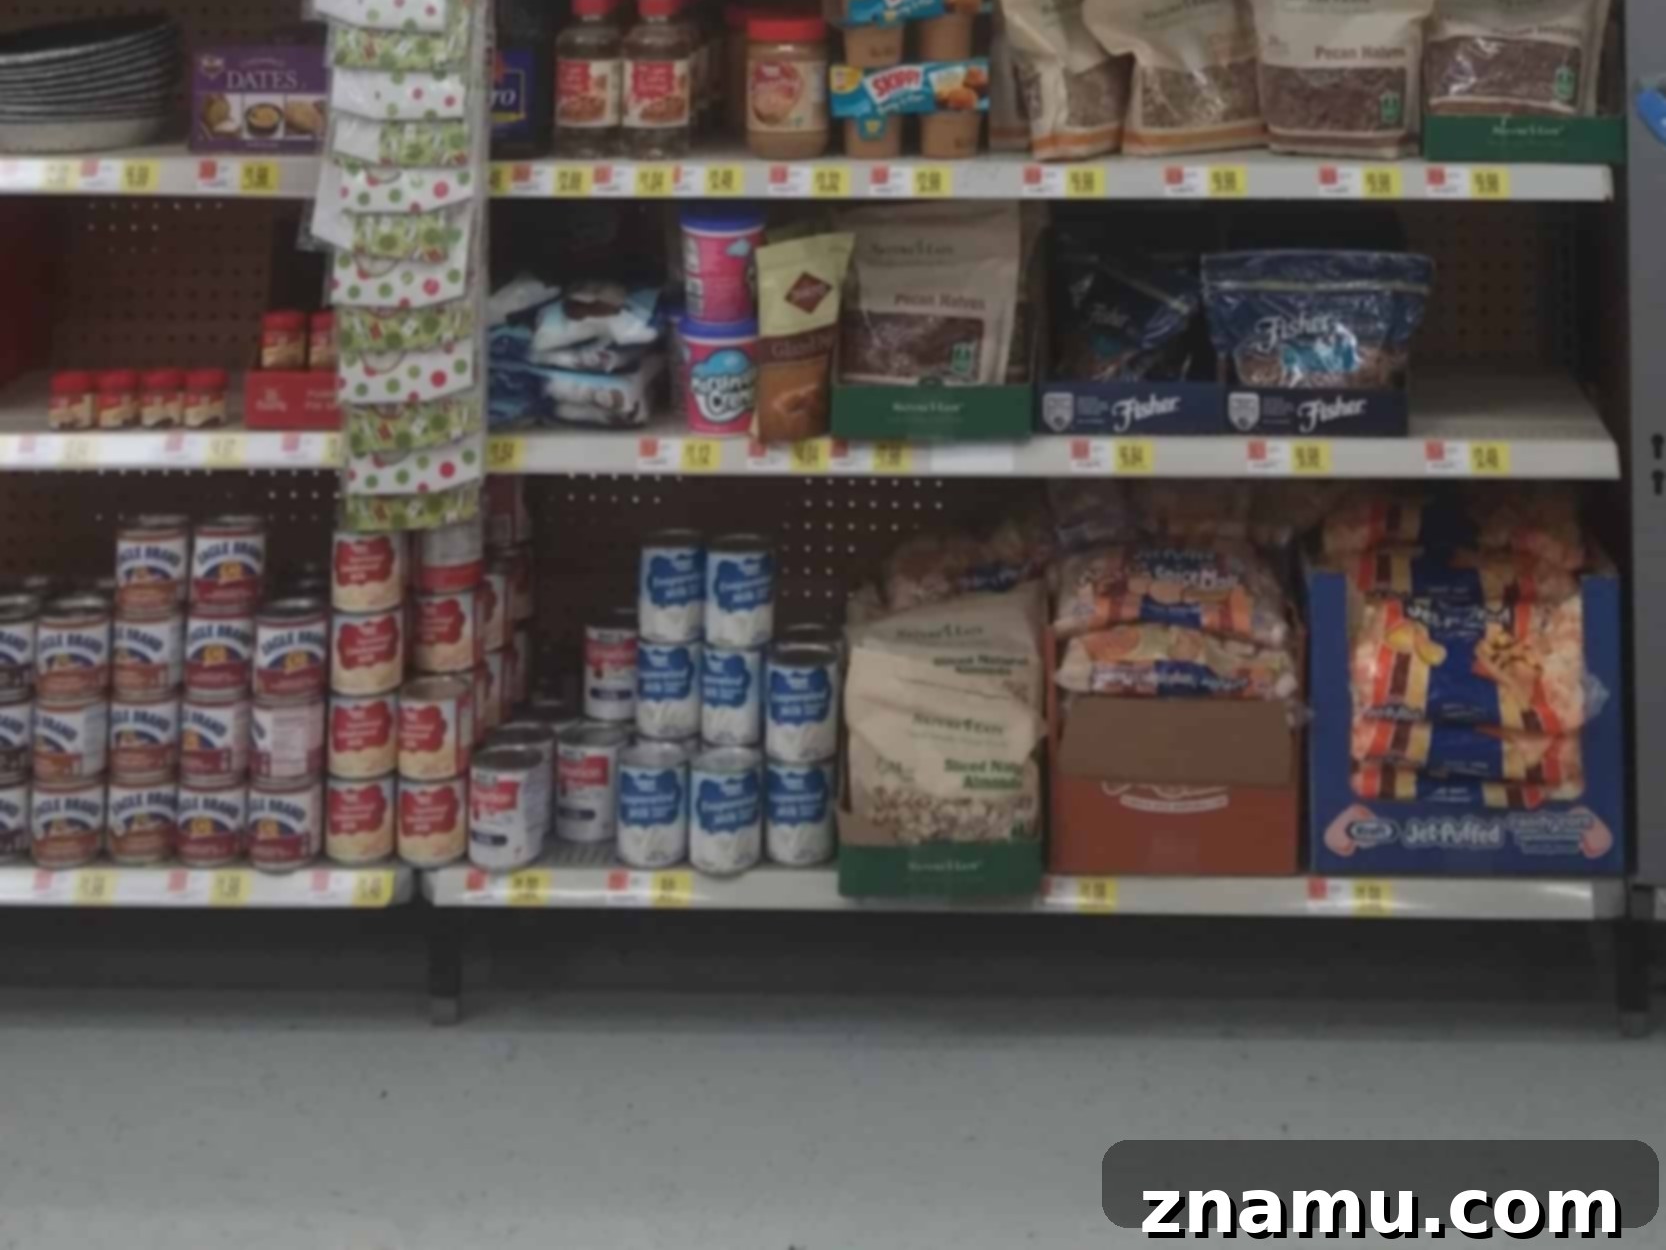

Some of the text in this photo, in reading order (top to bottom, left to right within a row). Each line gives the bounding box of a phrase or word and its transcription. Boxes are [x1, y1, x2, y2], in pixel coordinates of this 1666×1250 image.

[1314, 45, 1358, 60] Pecan
[225, 69, 298, 90] DATES
[872, 68, 923, 98] SKIPPY
[1253, 309, 1335, 353] Fisher
[1111, 392, 1181, 433] Fisher
[1297, 393, 1368, 434] Fisher
[944, 757, 987, 773] Sliced
[1406, 821, 1500, 844] Jet-Puffed
